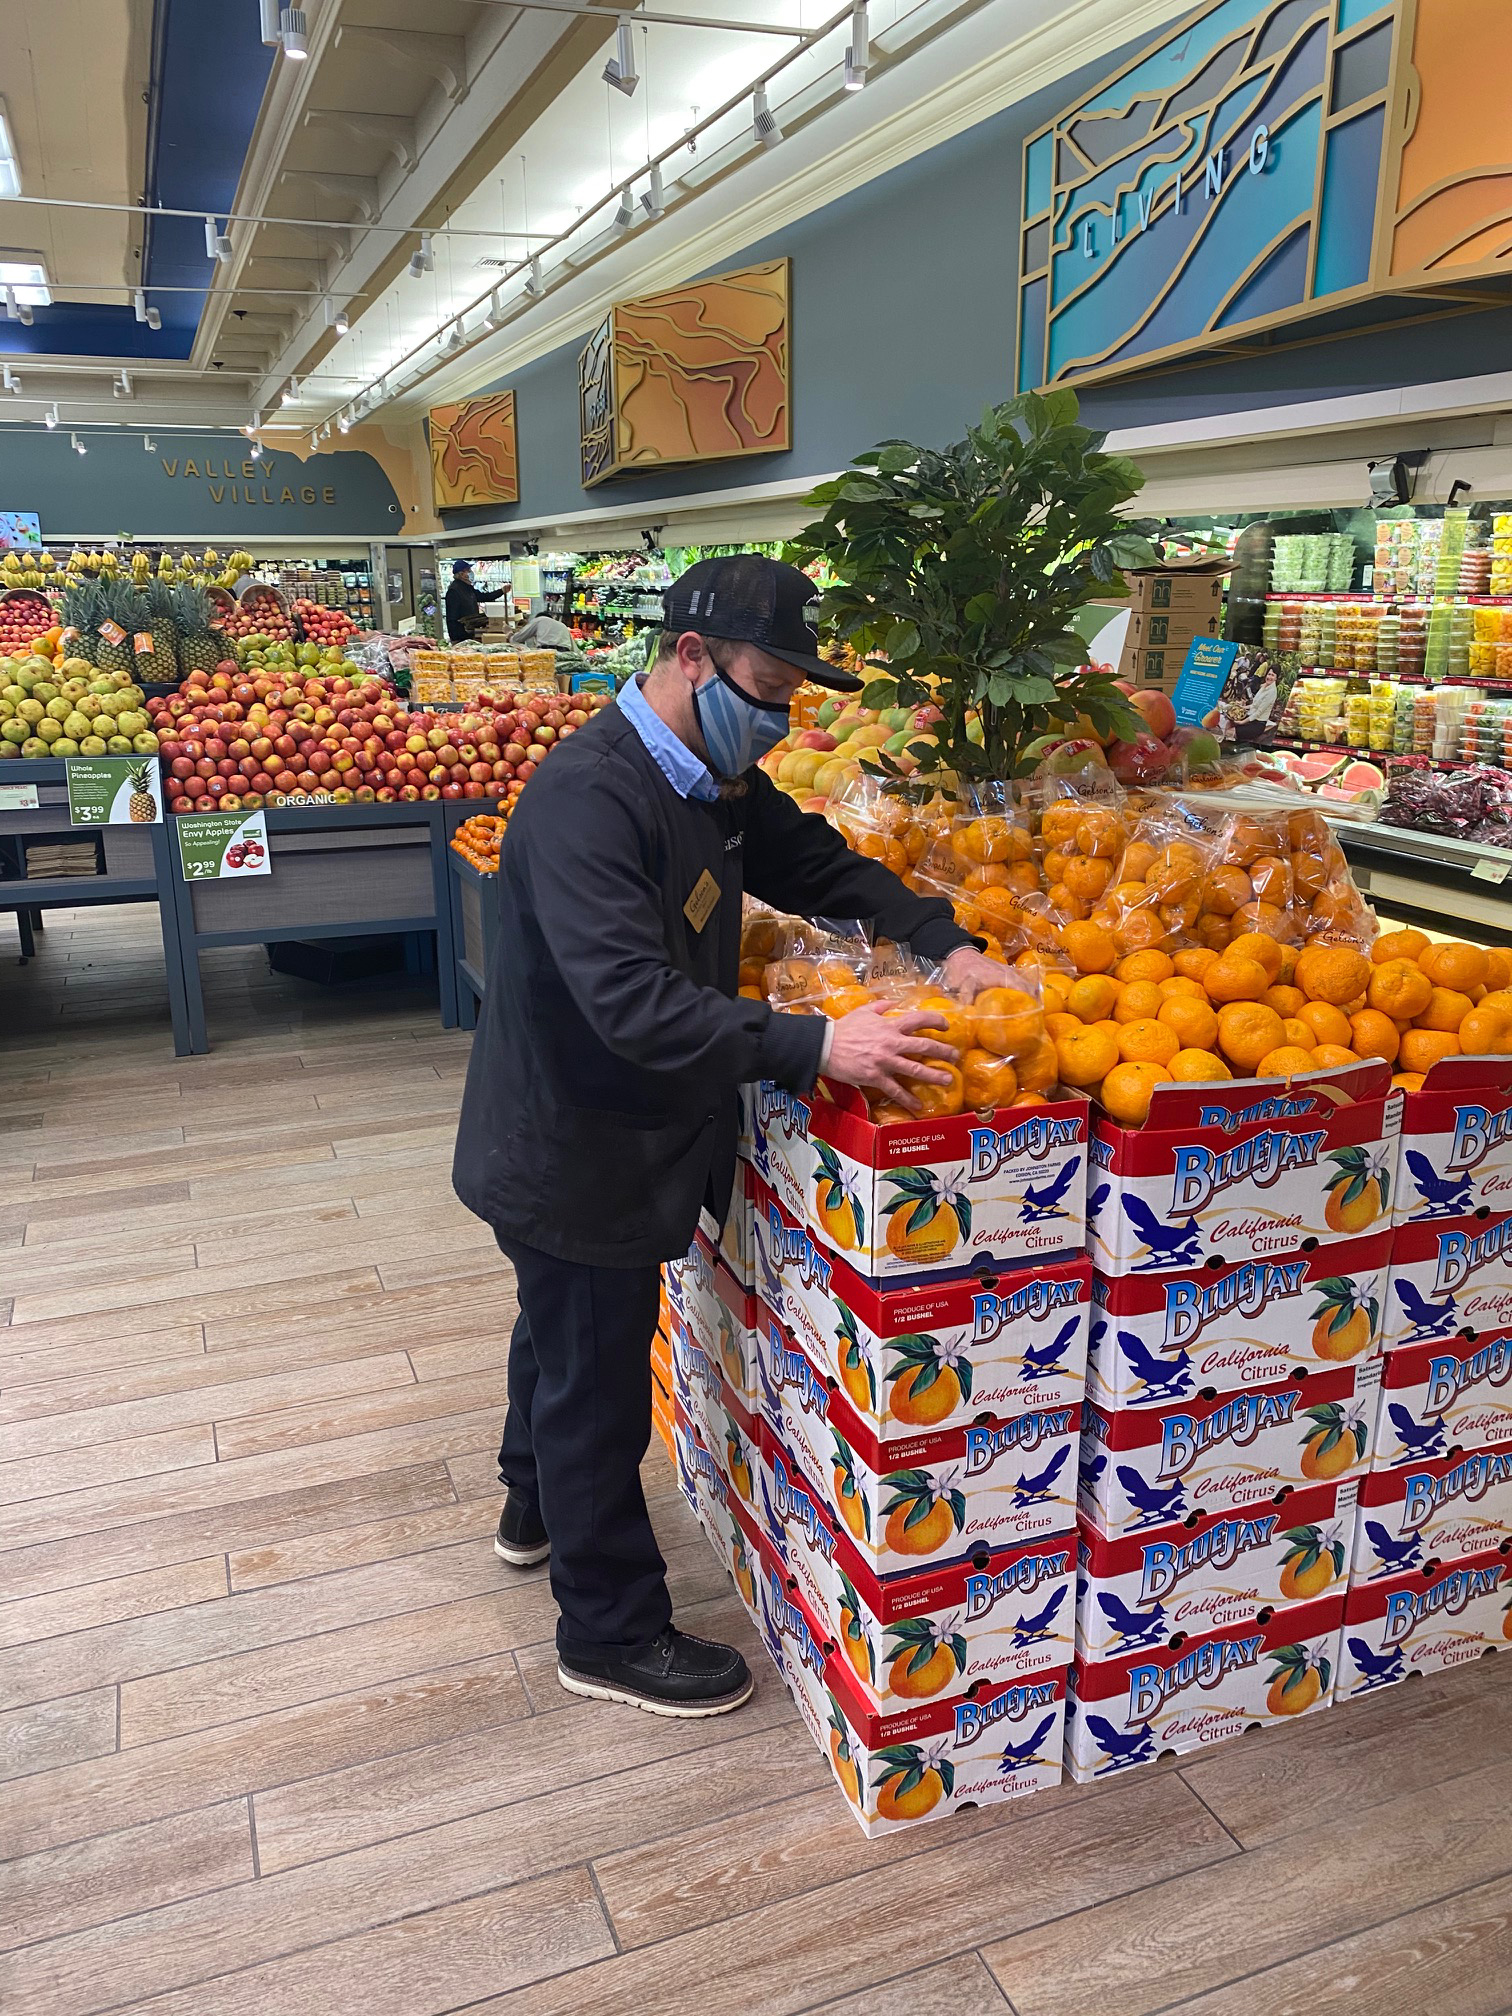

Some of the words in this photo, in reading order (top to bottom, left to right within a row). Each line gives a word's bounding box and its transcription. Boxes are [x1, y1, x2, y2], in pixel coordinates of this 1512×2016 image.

[1083, 124, 1269, 258] LIVING
[162, 459, 275, 478] VALLEY
[208, 485, 336, 504] VILLAGE
[71, 772, 112, 780] Pineapples
[1078, 783, 1114, 796] Gelson's
[276, 794, 337, 806] ORGANIC
[181, 821, 223, 830] Washington
[183, 830, 203, 839] Envy
[205, 828, 235, 837] Apples
[1184, 813, 1224, 839] Gelson's
[1009, 895, 1038, 917] Gelson's
[888, 1137, 921, 1147] PRODUCE
[921, 1135, 930, 1143] OF
[931, 1134, 945, 1142] USA
[902, 1144, 930, 1153] BUSHEL
[973, 1225, 1041, 1247] California
[1210, 1213, 1304, 1244] California
[1025, 1234, 1063, 1249] Citrus
[1252, 1233, 1298, 1253] Citrus
[893, 1306, 924, 1315] PRODUCE
[935, 1301, 949, 1309] USA
[907, 1312, 933, 1321] BUSHEL
[787, 1296, 827, 1350] California
[806, 1335, 828, 1368] Citrus
[1201, 1343, 1291, 1374] California
[1241, 1362, 1286, 1382] Citrus
[972, 1384, 1039, 1406] California
[1023, 1392, 1061, 1406] Citrus
[786, 1416, 824, 1475] California
[888, 1442, 918, 1452] PRODUCE
[901, 1448, 927, 1458] BUSHEL
[804, 1457, 825, 1493] Citrus
[1194, 1467, 1280, 1501] California
[1232, 1484, 1275, 1506] Citrus
[966, 1511, 1031, 1534] California
[1016, 1518, 1052, 1532] Citrus
[1429, 1520, 1504, 1549] California
[1461, 1536, 1500, 1553] Citrus
[791, 1549, 830, 1614] California
[891, 1594, 920, 1603] PRODUCE
[931, 1586, 944, 1594] USA
[904, 1598, 929, 1608] BUSHEL
[808, 1591, 830, 1629] Citrus
[1175, 1588, 1259, 1623] California
[1212, 1604, 1256, 1626] Citrus
[1410, 1631, 1486, 1663] California
[1443, 1646, 1481, 1666] Citrus
[967, 1651, 1030, 1676] California
[1016, 1655, 1052, 1670] Citrus
[787, 1660, 822, 1730] California
[802, 1704, 822, 1745] Citrus
[880, 1720, 908, 1731] PRODUCE
[892, 1724, 917, 1735] BUSHEL
[1162, 1705, 1246, 1741] California
[1200, 1721, 1242, 1742] Citrus
[954, 1774, 1016, 1799] California
[1003, 1778, 1038, 1793] Citrus
